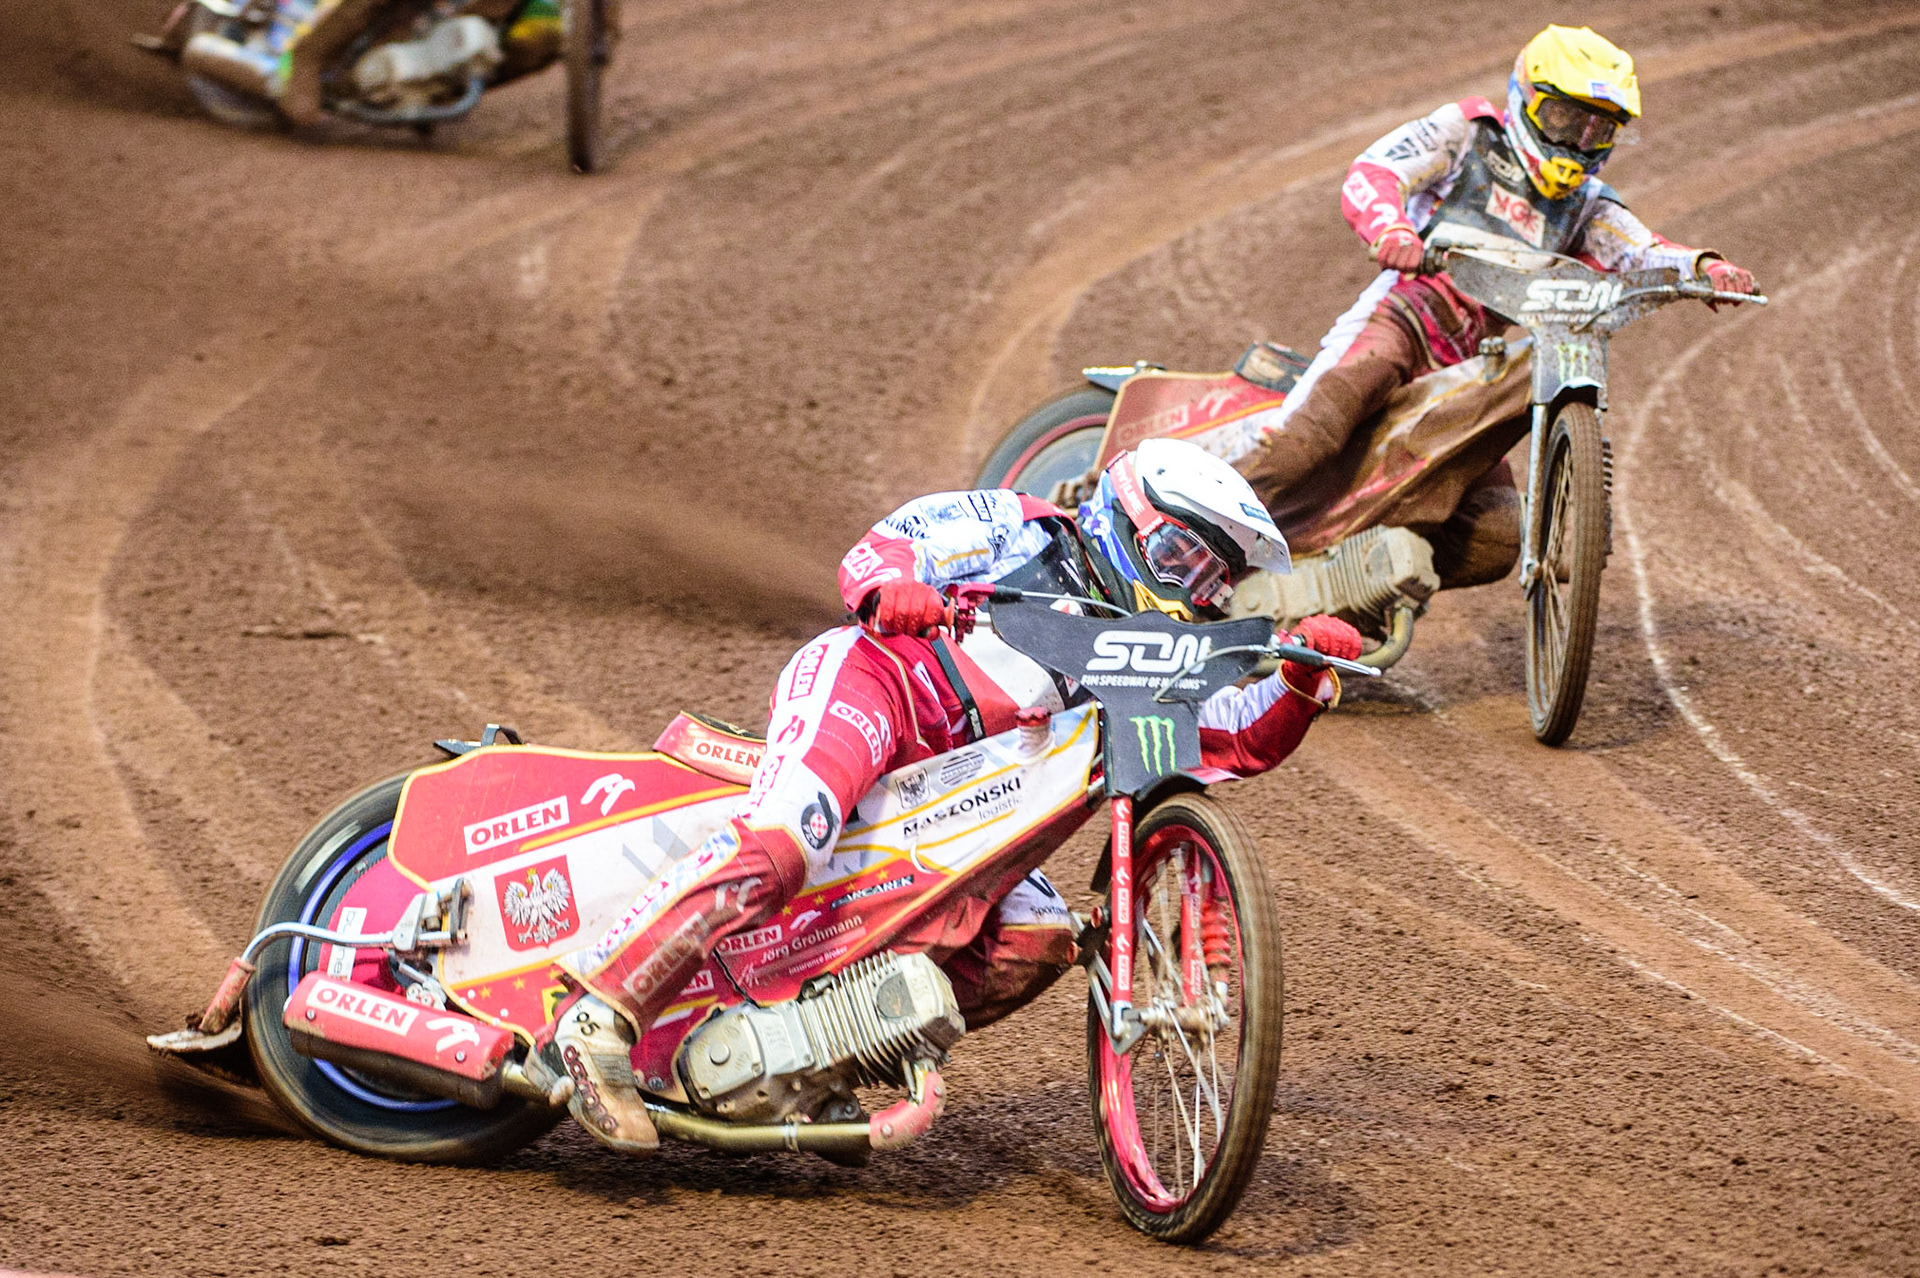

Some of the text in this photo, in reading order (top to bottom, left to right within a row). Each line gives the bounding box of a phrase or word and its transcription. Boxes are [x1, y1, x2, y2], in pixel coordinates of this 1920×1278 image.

[1100, 675, 1148, 688] SPEEDWAY
[838, 706, 882, 763] ORLEN
[696, 742, 761, 769] ORLEN
[471, 804, 562, 846] ORLEN
[716, 929, 778, 952] ORLEN
[761, 915, 862, 964] Jörg Grohmann
[316, 988, 408, 1028] ORLEN
